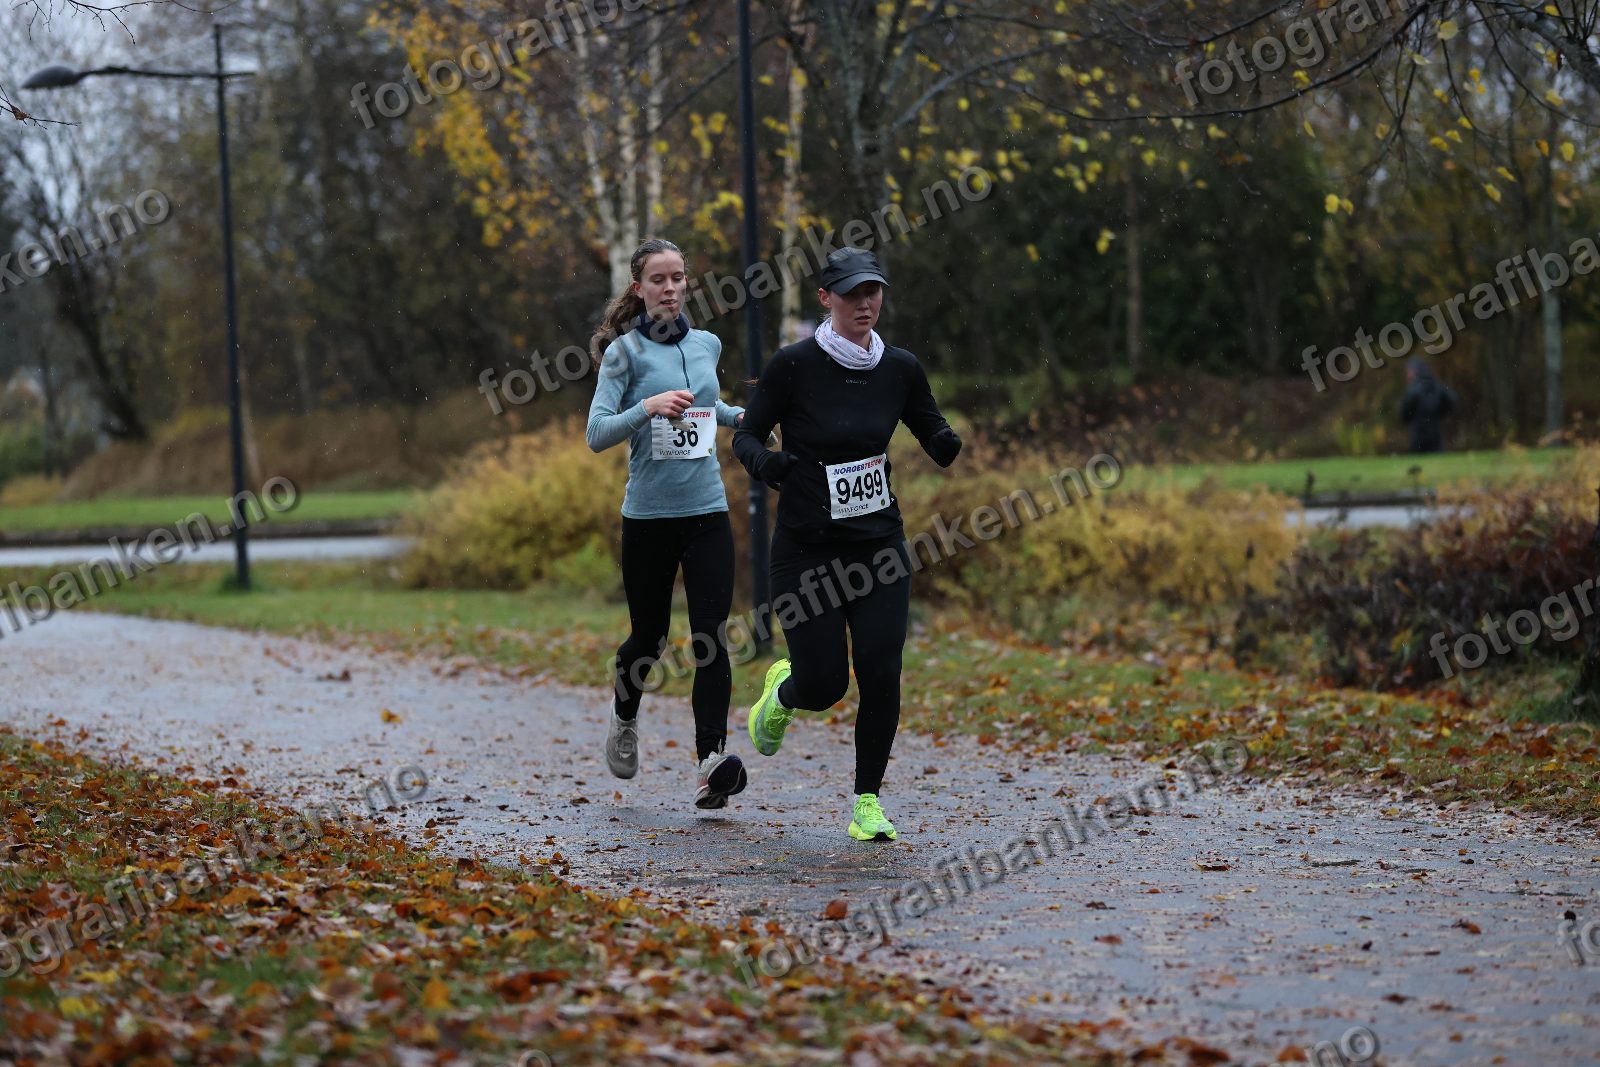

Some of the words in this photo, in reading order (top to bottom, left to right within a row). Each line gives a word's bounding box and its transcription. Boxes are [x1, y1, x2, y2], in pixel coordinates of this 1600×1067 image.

[672, 422, 699, 448] 36
[833, 458, 883, 475] NORGESTESTEN
[836, 469, 883, 505] 9499
